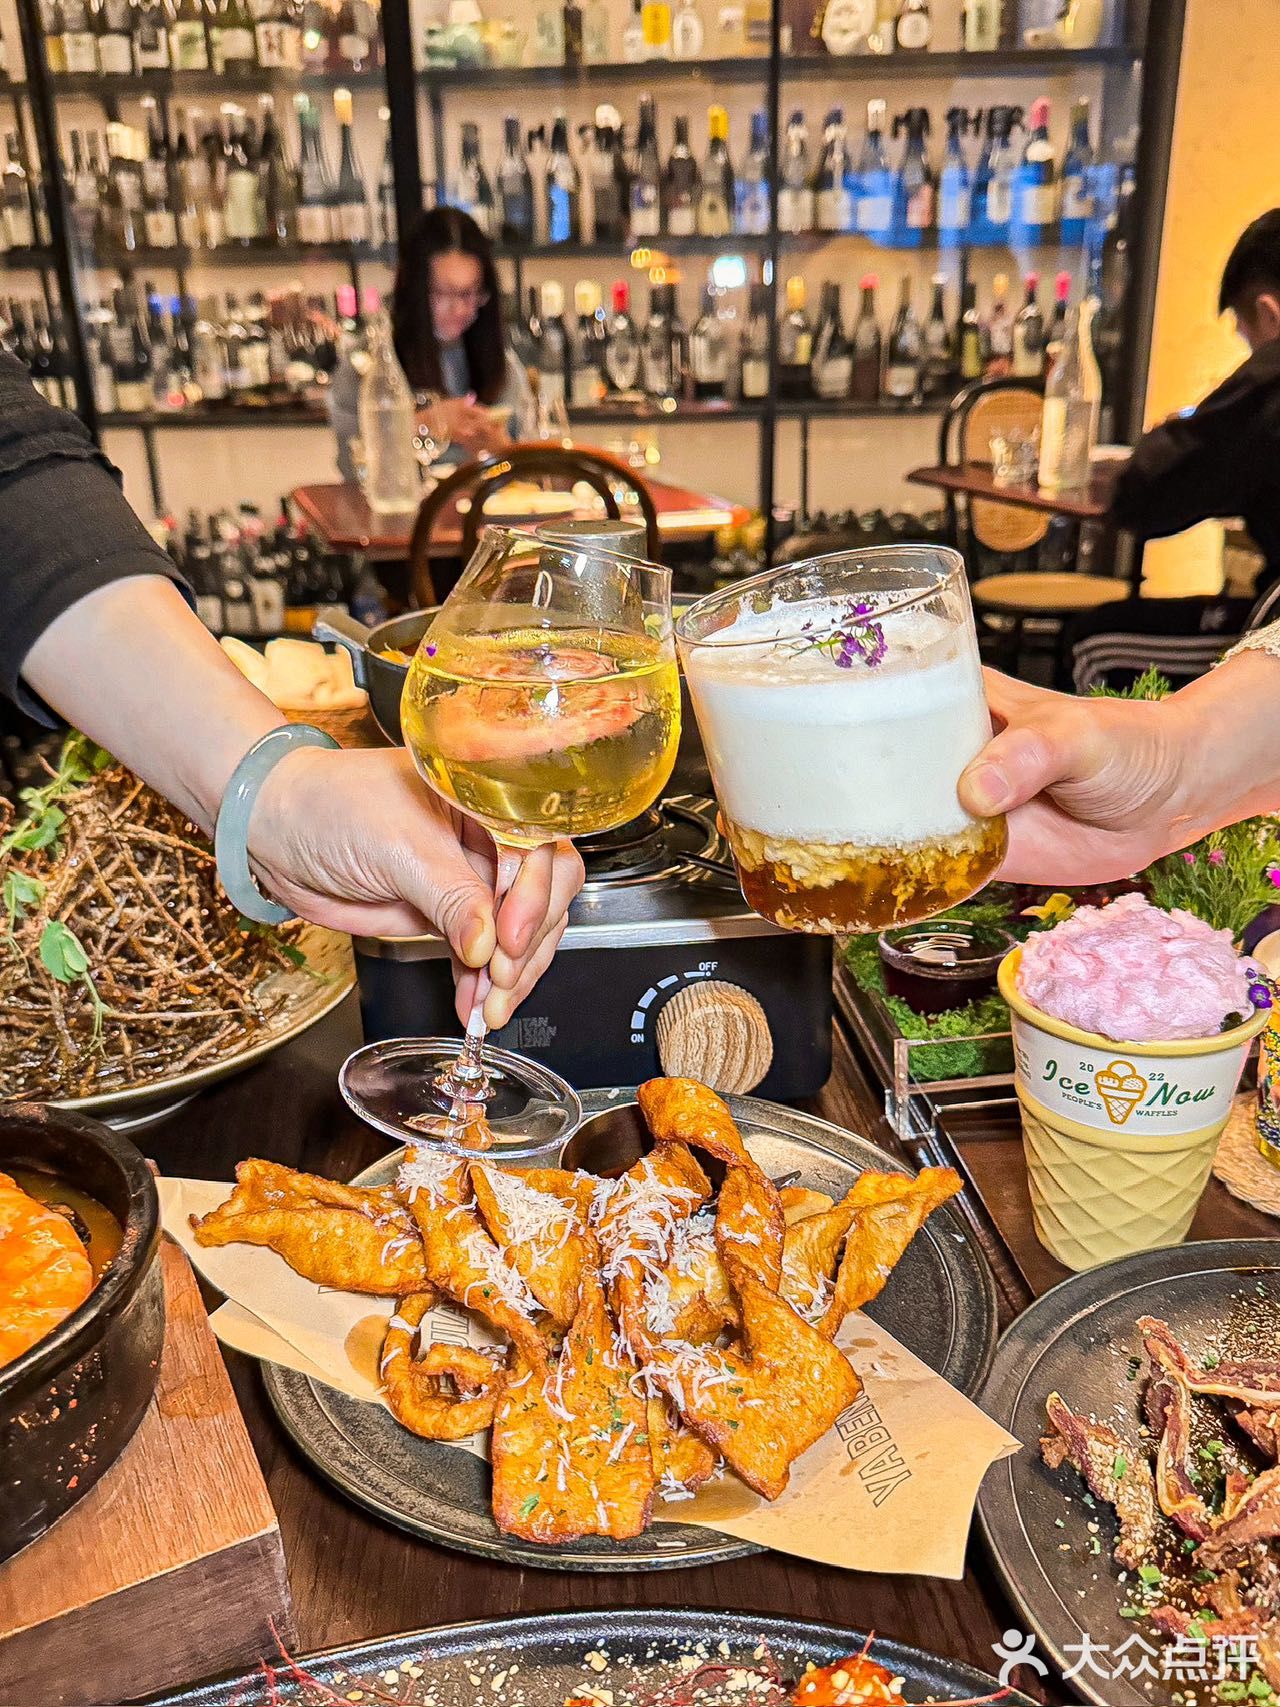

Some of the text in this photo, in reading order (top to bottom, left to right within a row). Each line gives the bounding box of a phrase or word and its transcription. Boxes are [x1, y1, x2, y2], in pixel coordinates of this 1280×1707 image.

[698, 961, 718, 971] OFF
[630, 1034, 645, 1043] ON
[1079, 1061, 1165, 1081] 20 22
[1042, 1059, 1090, 1095] Ice
[1145, 1082, 1216, 1106] Now
[1061, 1091, 1178, 1117] PEOPLE'S WAFFLES
